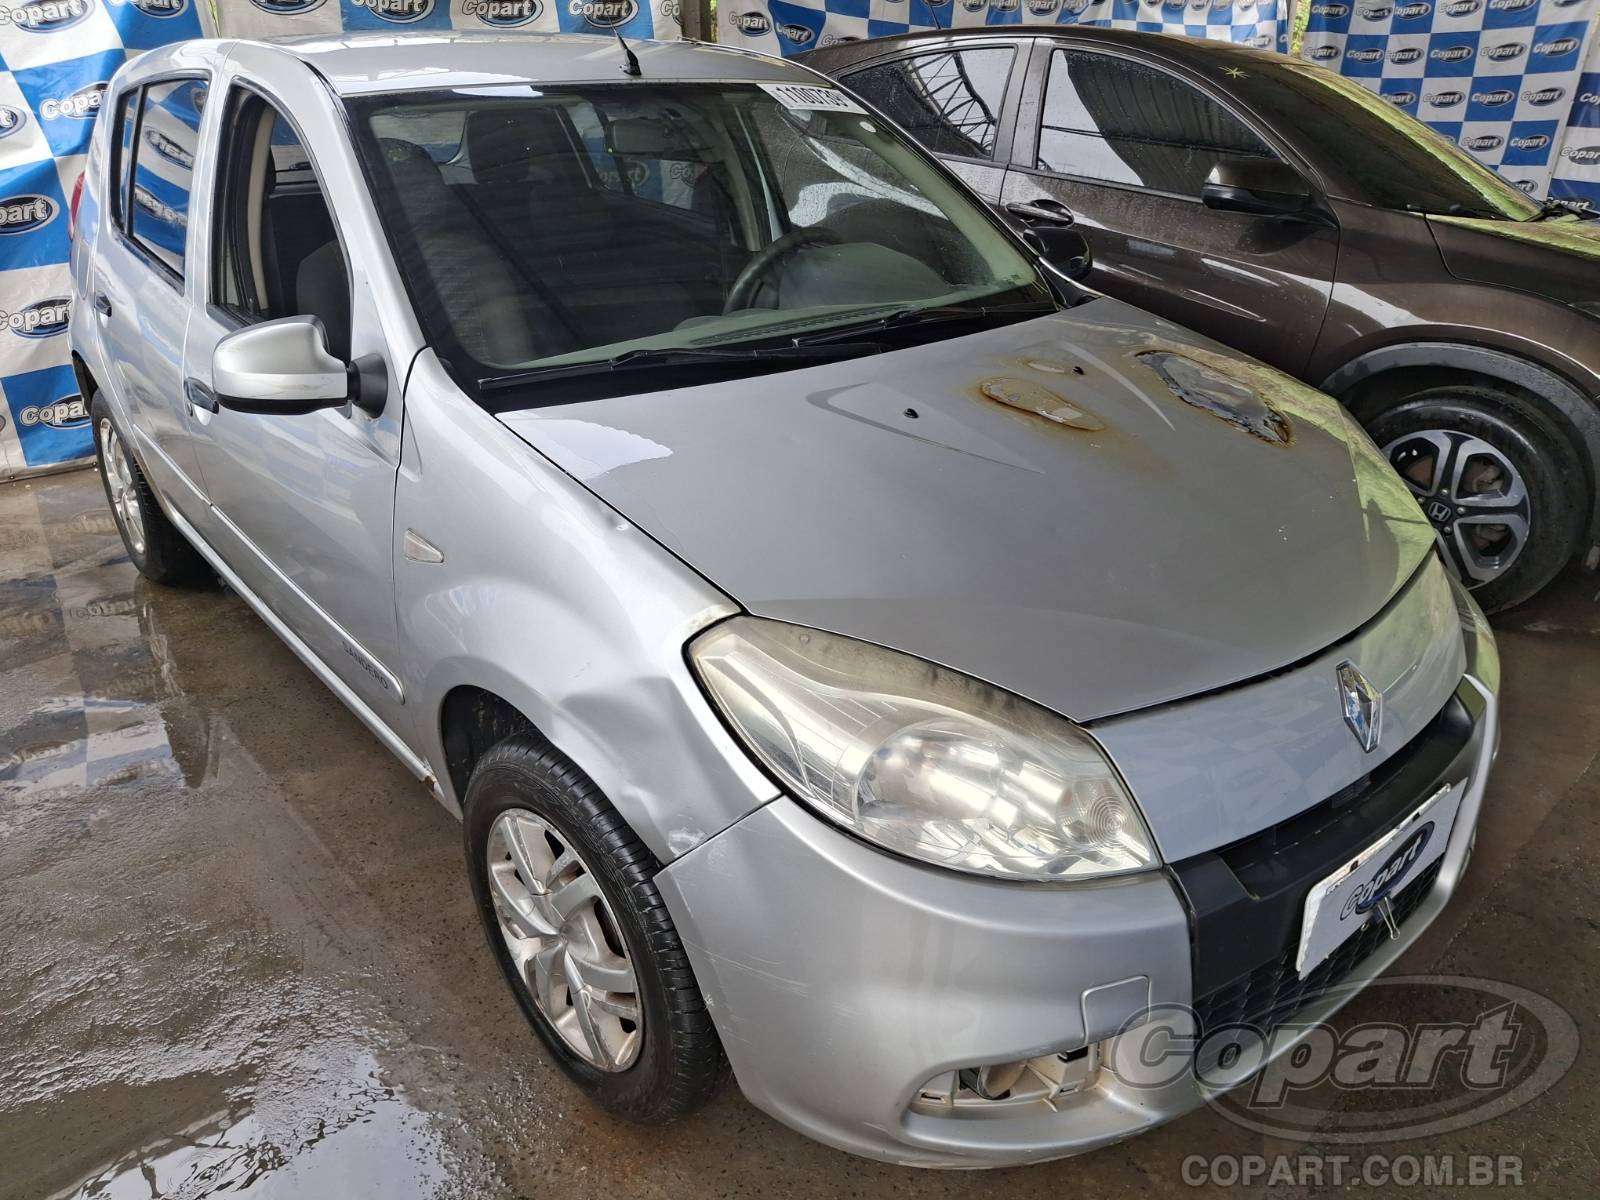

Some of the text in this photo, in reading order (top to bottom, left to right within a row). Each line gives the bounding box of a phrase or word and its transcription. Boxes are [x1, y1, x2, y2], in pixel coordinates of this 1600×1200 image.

[462, 0, 532, 19] Copart
[569, 0, 628, 19] Copart
[1311, 3, 1345, 16] Copart
[1346, 49, 1382, 61] Copart
[1430, 48, 1470, 60] Copart
[1481, 46, 1522, 59] Copart
[1533, 41, 1575, 56] Copart
[1471, 90, 1511, 103] Copart
[1521, 89, 1561, 103] Copart
[1580, 92, 1600, 106] Cop
[40, 91, 108, 120] Copa
[1510, 136, 1548, 150] Copart
[1561, 146, 1600, 160] Copar
[0, 198, 48, 226] part
[20, 401, 88, 427] Copa
[1340, 836, 1424, 921] Copart
